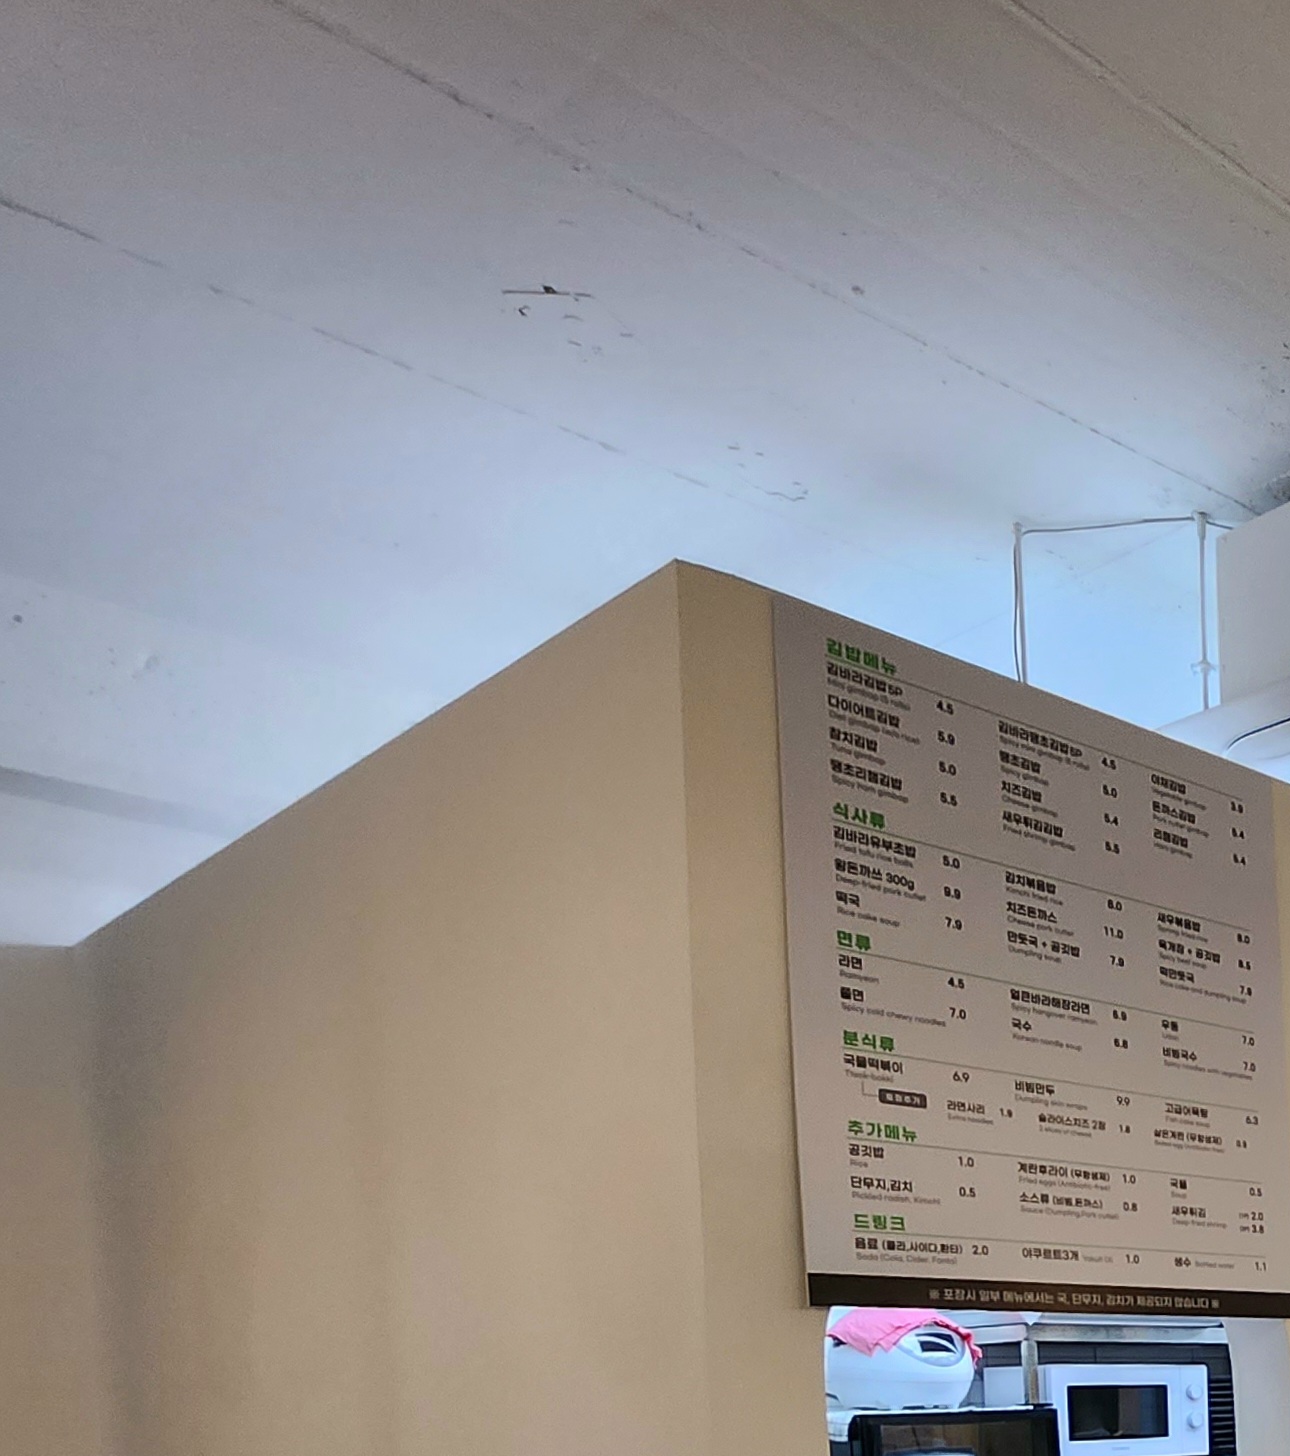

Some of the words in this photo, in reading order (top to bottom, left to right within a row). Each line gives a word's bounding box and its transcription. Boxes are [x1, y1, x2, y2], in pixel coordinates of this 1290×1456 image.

[826, 638, 897, 676] 김밥메뉴
[936, 699, 954, 715] 4.5
[828, 694, 900, 728] 다이어트김밥
[937, 730, 956, 746] 5.9
[829, 726, 878, 753] 참치김밥
[938, 760, 957, 776] 5.0
[1102, 757, 1117, 770] 4.5
[940, 792, 958, 807] 5.5
[1001, 780, 1043, 803] 치즈김밥
[1103, 784, 1118, 798] 5.0
[833, 802, 885, 829] 식사류
[1105, 841, 1120, 854] 5.5
[942, 855, 961, 869] 5.0
[885, 872, 915, 891] 300g
[1005, 871, 1057, 895] 김치볶음밥
[835, 890, 860, 907] 떡국
[945, 916, 963, 931] 7.9
[1006, 901, 1058, 923] 치즈돈까스
[1103, 926, 1124, 940] 11.0
[836, 930, 871, 950] 면류
[838, 954, 863, 970] 라면
[947, 977, 965, 990] 4.5
[949, 1007, 967, 1020] 7.0
[1011, 1018, 1032, 1032] 국수
[843, 1029, 895, 1052] 분식류
[1162, 1046, 1198, 1062] 비빔국수
[843, 1053, 904, 1075] 국물떡볶이
[952, 1070, 970, 1083] 6.9
[1014, 1079, 1056, 1096] 비빔만두
[1116, 1095, 1131, 1107] 9.9
[946, 1099, 986, 1115] 라면사리
[848, 1120, 917, 1142] 추가메뉴
[848, 1143, 885, 1159] 공깃밥
[958, 1155, 975, 1168] 1.0
[1017, 1161, 1068, 1178] 계란후라이
[1122, 1173, 1137, 1184] 1.0
[850, 1175, 914, 1193] 단무지,김치
[958, 1186, 976, 1198] 0.5
[1249, 1187, 1263, 1197] 0.5
[1020, 1191, 1049, 1205] 소스류
[853, 1213, 905, 1231] 드링크
[1251, 1211, 1264, 1221] 2.0
[854, 1237, 878, 1250] 음료
[972, 1244, 990, 1256] 2.0
[1022, 1247, 1079, 1261] 야쿠르트3개
[1125, 1253, 1140, 1264] 1.0
[1174, 1256, 1191, 1268] 생수
[1254, 1261, 1267, 1272] 1.1
[943, 1289, 977, 1301] 포장시
